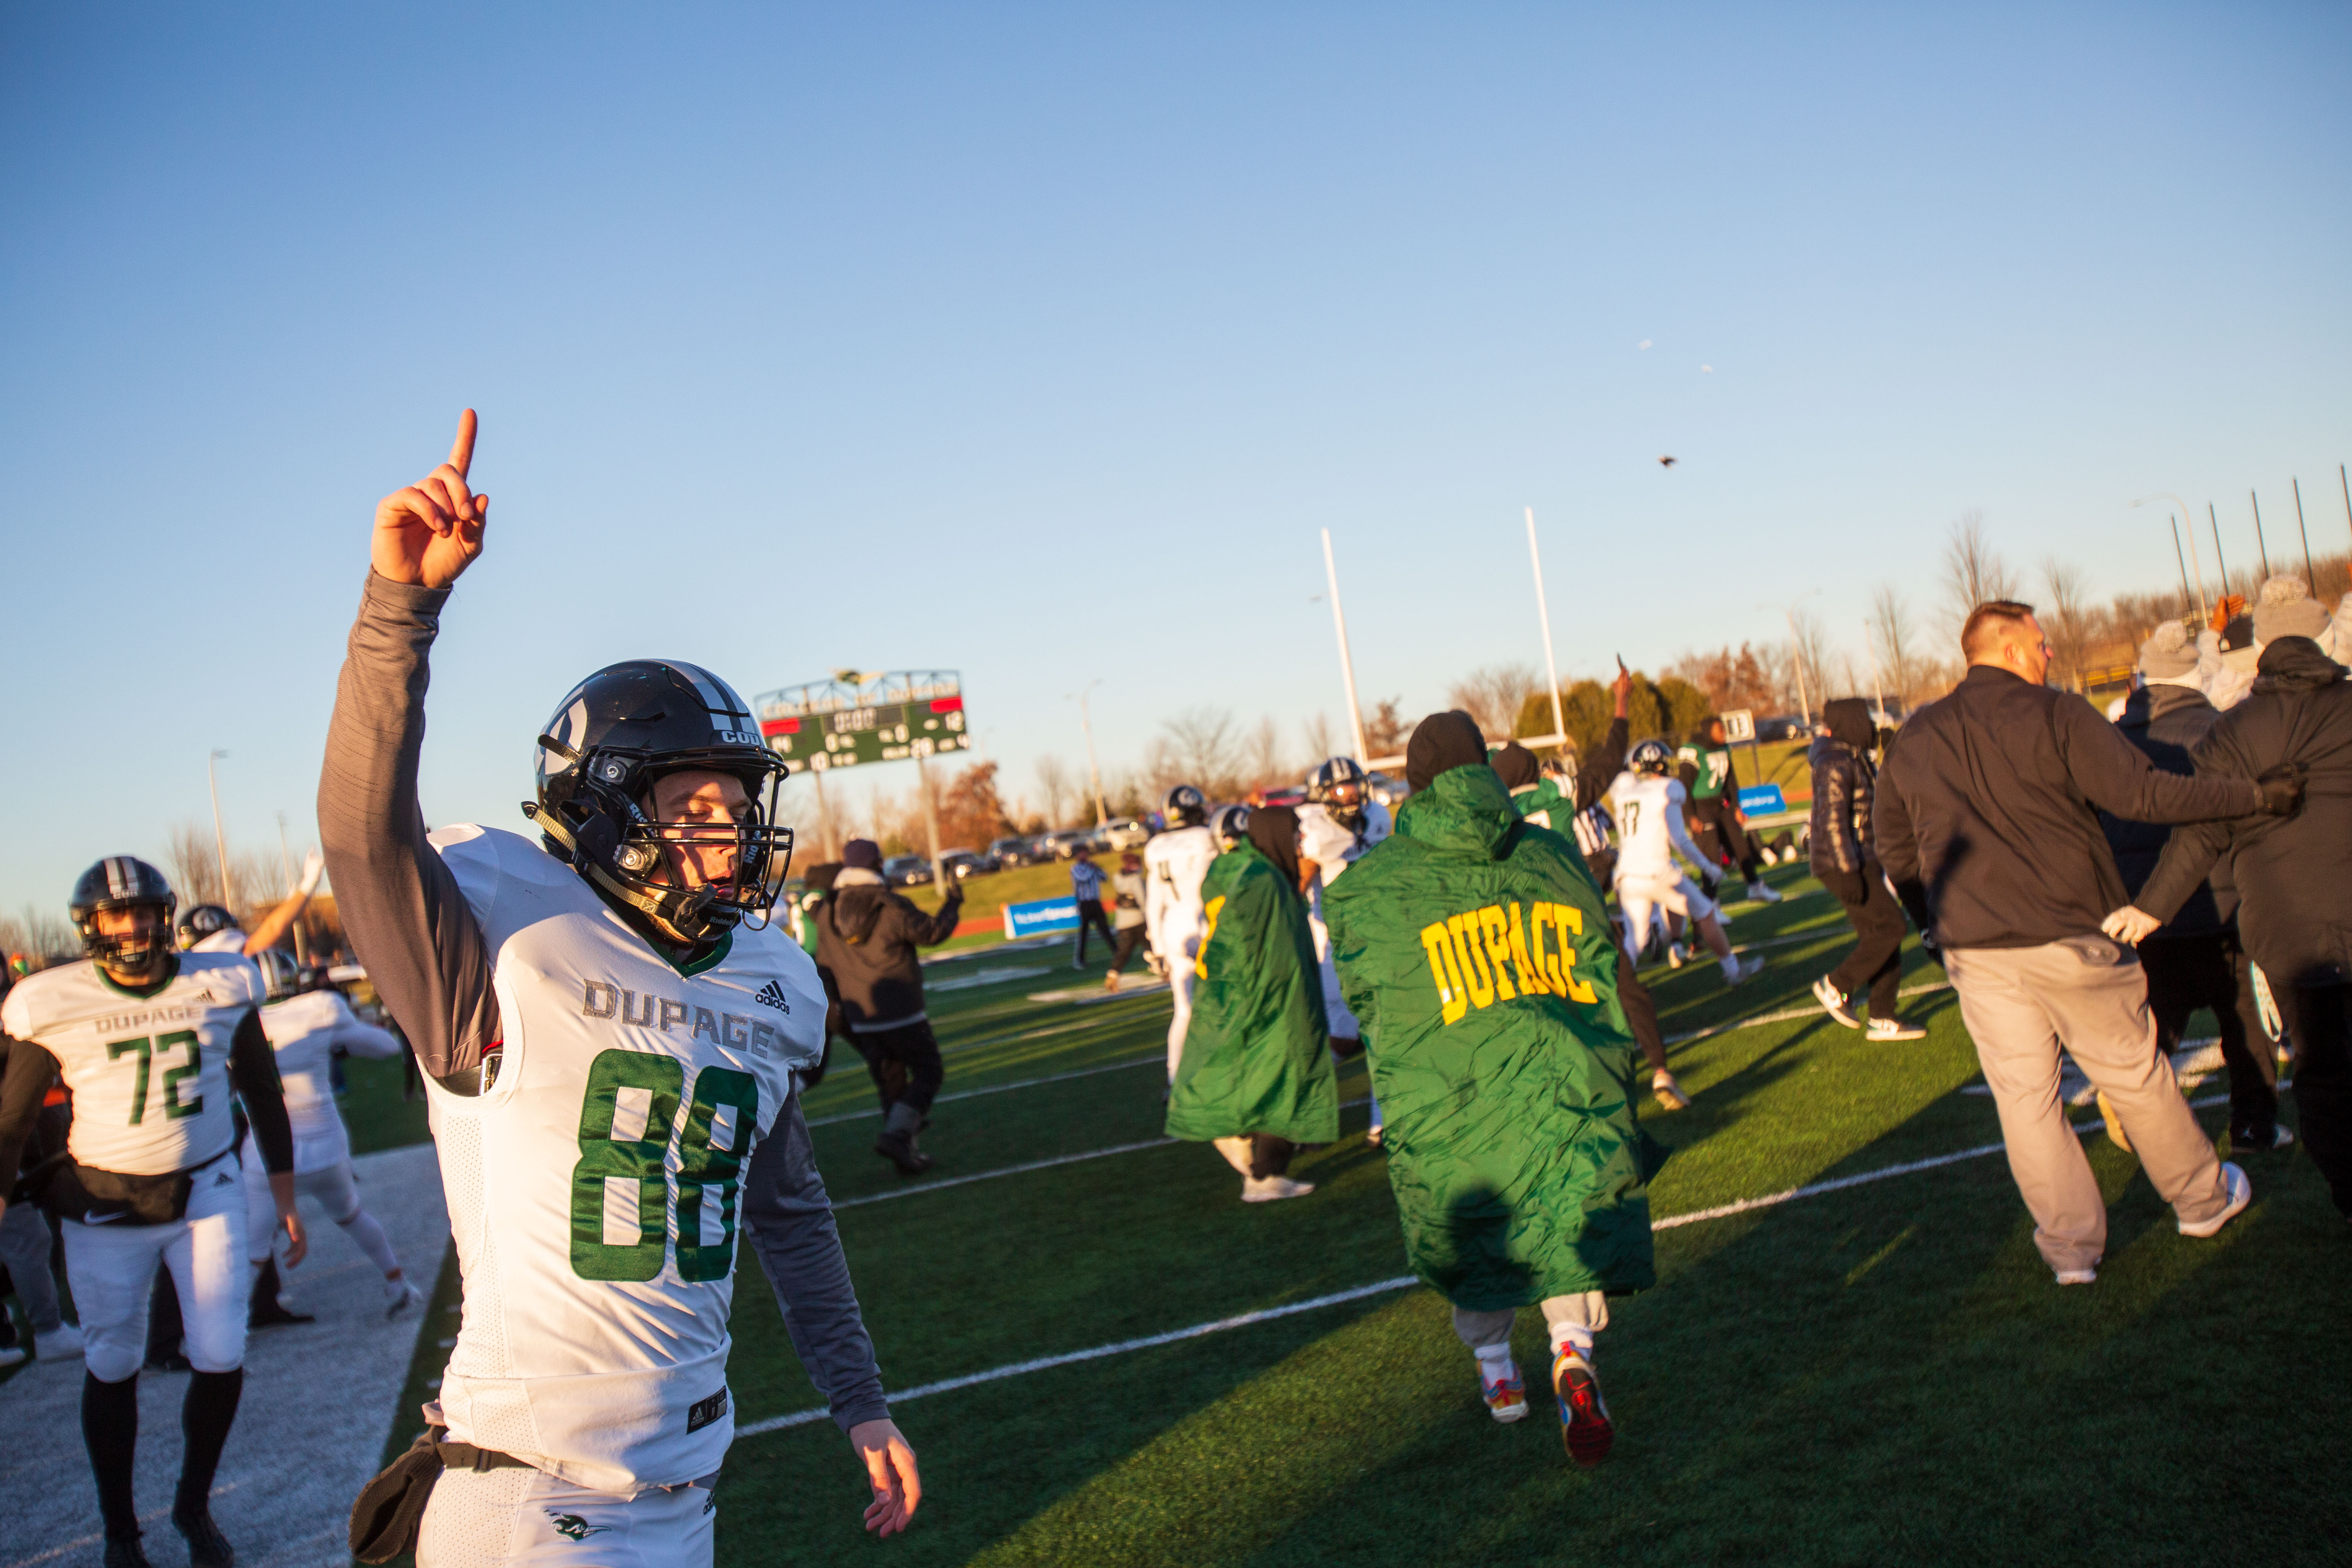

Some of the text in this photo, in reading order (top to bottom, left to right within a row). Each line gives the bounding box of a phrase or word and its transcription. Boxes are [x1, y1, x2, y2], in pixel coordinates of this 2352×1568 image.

[722, 731, 760, 746] COD
[1624, 801, 1640, 836] 17
[1421, 902, 1598, 1026] DUPAGE
[96, 1007, 202, 1034] DUPAGE
[582, 979, 775, 1058] DUPAGE
[755, 993, 790, 1015] adidas
[106, 1030, 203, 1126] 72
[570, 1048, 759, 1283] 88
